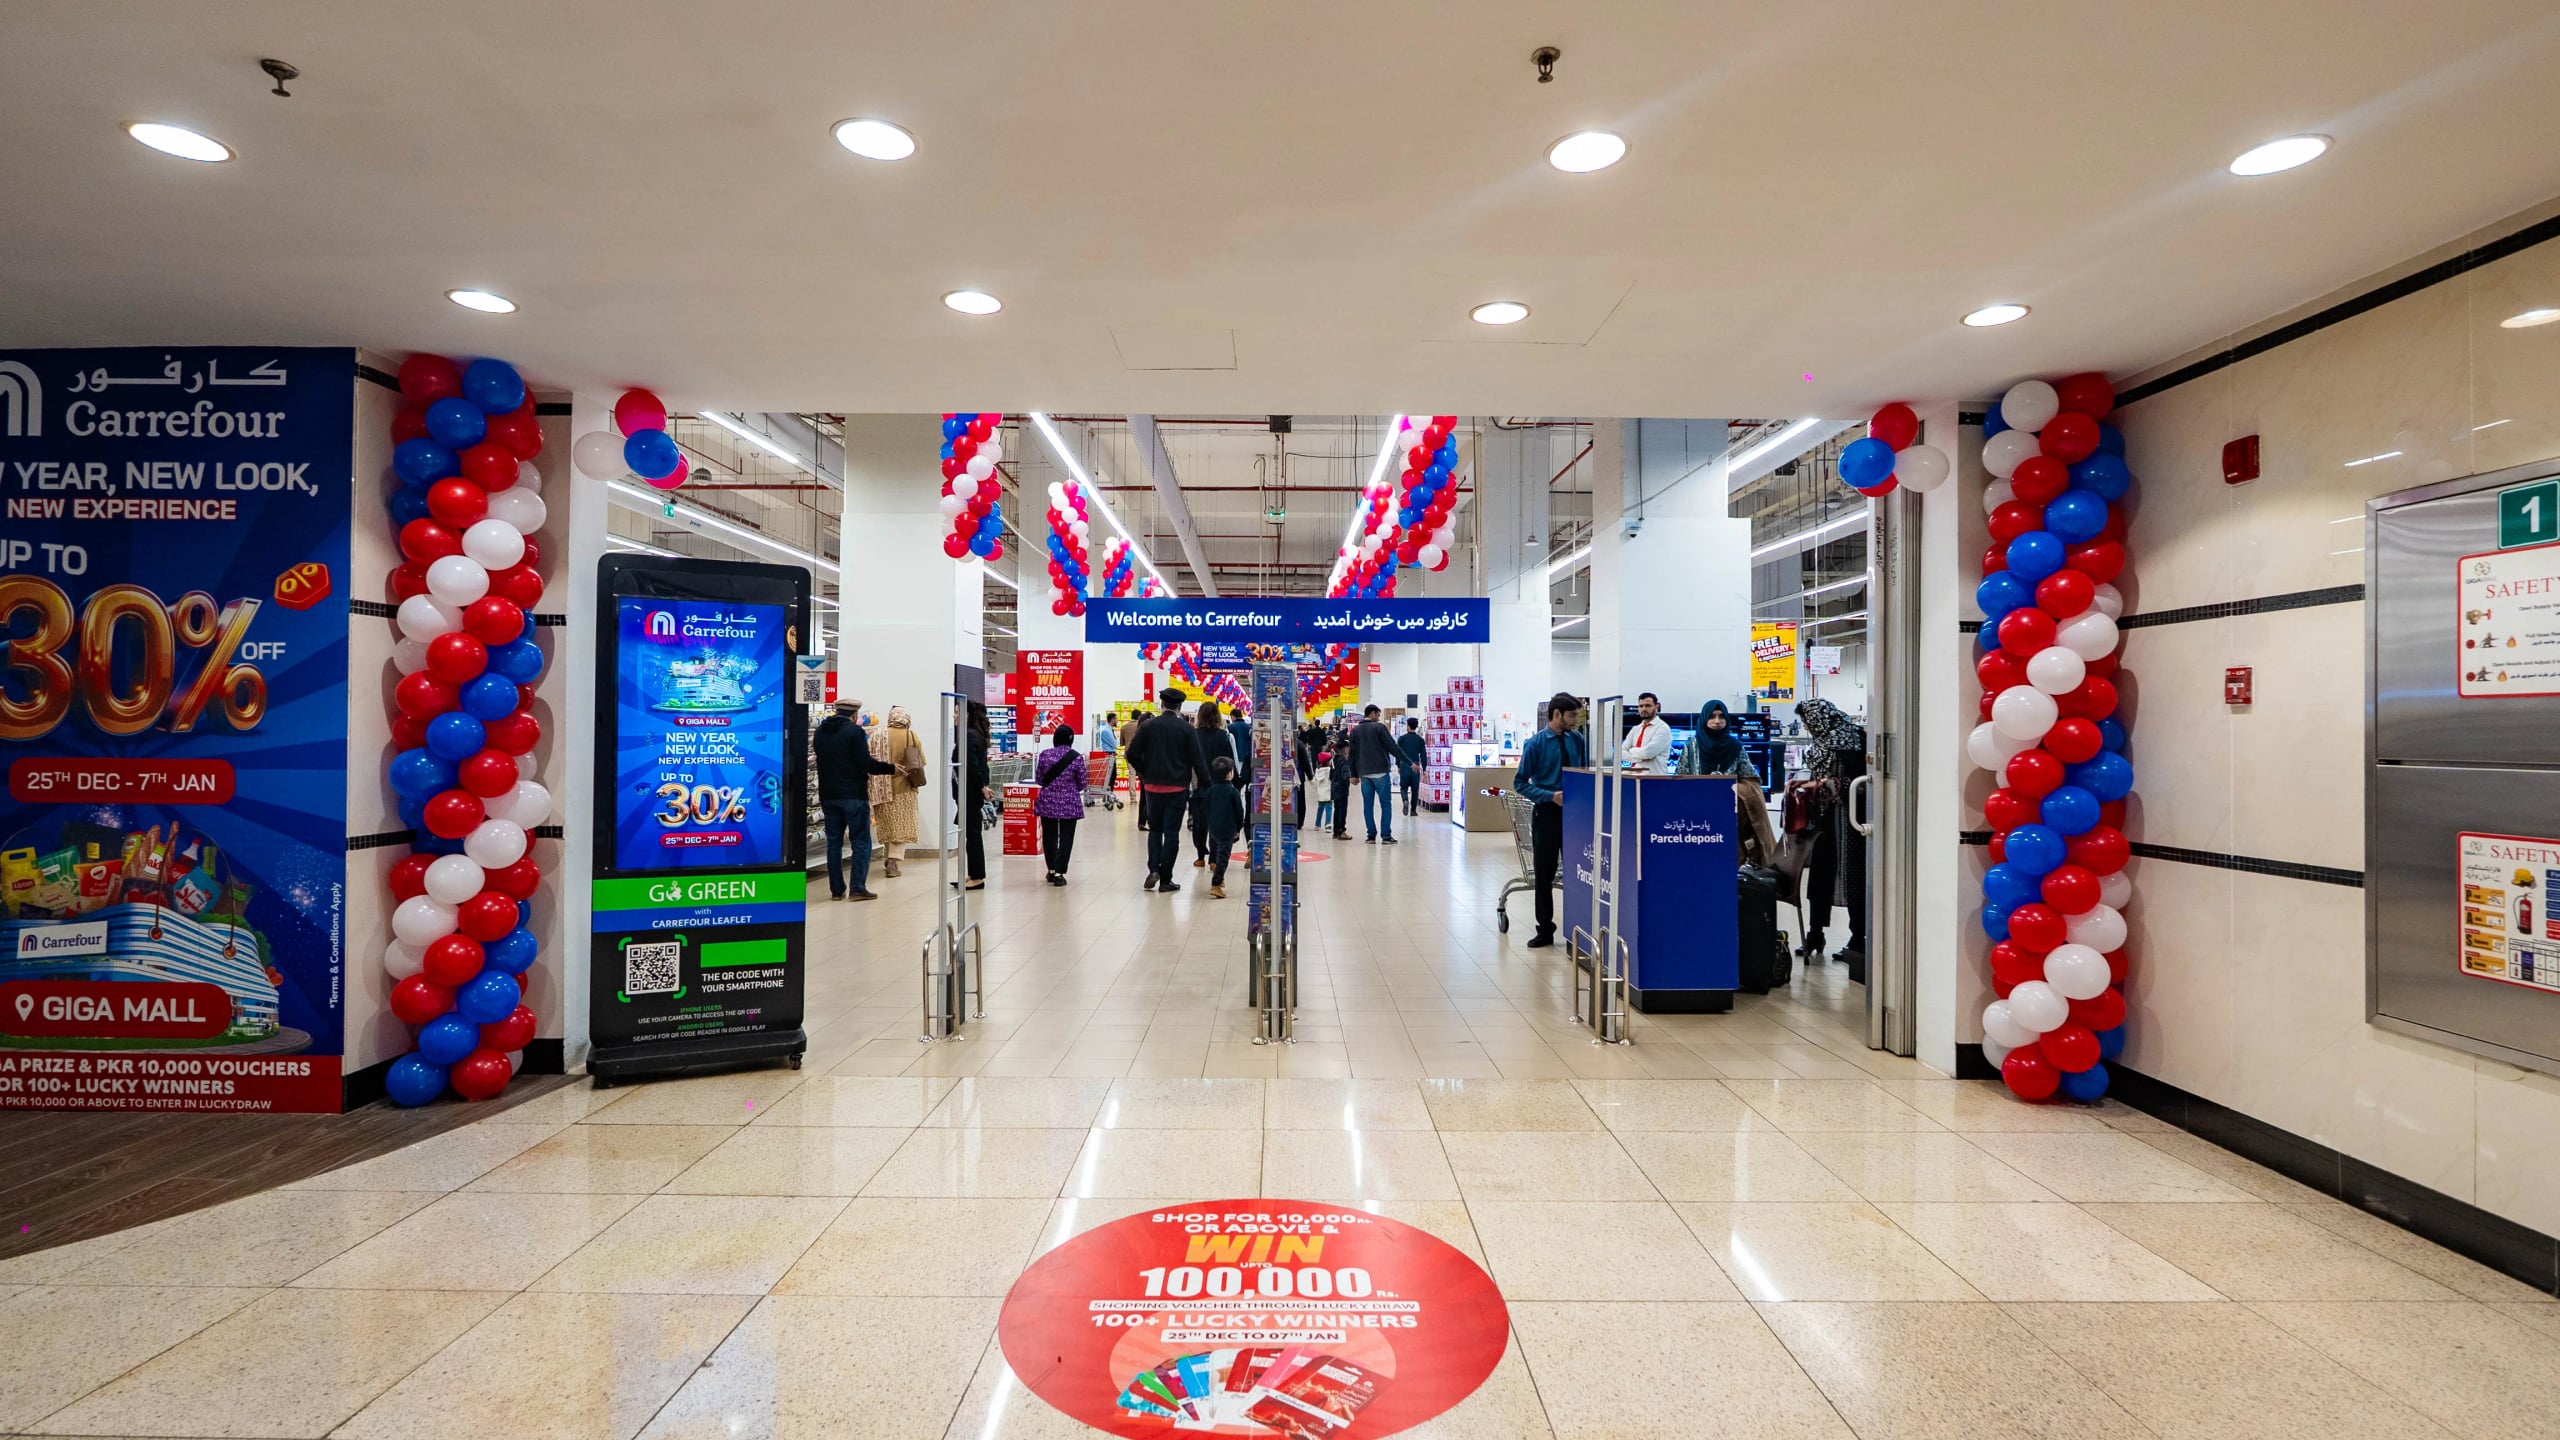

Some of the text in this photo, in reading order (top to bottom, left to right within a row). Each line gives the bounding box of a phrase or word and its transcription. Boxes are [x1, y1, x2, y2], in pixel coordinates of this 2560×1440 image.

[66, 400, 286, 438] Carrefour
[14, 461, 116, 497] YEAR,
[125, 461, 206, 490] NEW
[215, 462, 319, 497] LOOK,
[7, 498, 237, 520] NEW EXPERIENCE
[2521, 495, 2541, 533] 1
[40, 543, 88, 576] TO
[1107, 611, 1282, 627] Welcome to Carrefour
[1353, 613, 1394, 630] خوش
[682, 624, 757, 638] Carrefour
[241, 641, 286, 661] OFF
[1751, 637, 1779, 651] FREE
[1755, 644, 1790, 657] DELIVERY
[0, 575, 268, 741] 30%
[1245, 642, 1284, 664] 30%
[1038, 674, 1063, 686] WIN
[666, 732, 739, 744] NEW YEAR,
[665, 745, 739, 756] NEW LOOK,
[658, 757, 745, 765] NEW EXPERIENCE
[27, 771, 71, 791] 25TH
[77, 772, 121, 791] DEC
[138, 772, 167, 792] 7TH
[173, 774, 216, 792] JAN
[661, 772, 694, 783] UP TO
[654, 782, 746, 828] 30%
[685, 836, 702, 844] DEC
[1650, 833, 1724, 845] Parcel deposit
[330, 883, 342, 912] Apply
[688, 881, 756, 901] GREEN
[2465, 889, 2472, 902] P
[694, 908, 712, 917] with
[2466, 911, 2473, 925] A
[652, 915, 752, 928] CARREFOUR LEAFLET
[41, 933, 103, 950] Carrefour
[329, 913, 340, 964] Conditions
[2465, 933, 2473, 946] S
[2465, 956, 2473, 969] S
[702, 968, 785, 982] THE QR CODE WITH
[702, 980, 785, 993] YOUR SMARTPHONE
[43, 996, 206, 1023] GIGA MALL
[668, 1013, 693, 1022] CAMERA
[701, 1011, 724, 1019] ACCESS
[680, 1030, 696, 1038] CODE
[697, 1028, 721, 1036] READER
[728, 1025, 751, 1033] GOOGLE
[20, 1058, 75, 1073] PRIZE
[79, 1058, 92, 1073] &
[97, 1059, 134, 1074] PKR
[138, 1060, 202, 1077] 10,000
[205, 1061, 311, 1077] VOUCHERS
[27, 1078, 71, 1092] 100+
[76, 1078, 139, 1093] LUCKY
[143, 1080, 235, 1095] WINNERS
[6, 1097, 28, 1107] PKR
[30, 1097, 66, 1108] 10,000
[69, 1098, 86, 1108] OR
[87, 1098, 126, 1108] ABOVE
[128, 1098, 145, 1108] TO
[147, 1099, 181, 1109] ENTER
[184, 1099, 197, 1109] IN
[199, 1100, 272, 1110] LUCKYDRAW
[1151, 1213, 1219, 1223] SHOP
[1223, 1213, 1271, 1224] FOR
[1184, 1224, 1340, 1234] OR ABOVE &
[1184, 1235, 1325, 1264] WIN
[1139, 1266, 1399, 1300] 100,000 Rs.
[1093, 1302, 1417, 1310] SHOPPING VOUCHER THROUGH LUCKY DRAW
[1091, 1313, 1418, 1328] 100+ LUCKY WINNERS
[1167, 1332, 1339, 1341] 25TH DEC TO 07TH JAN
